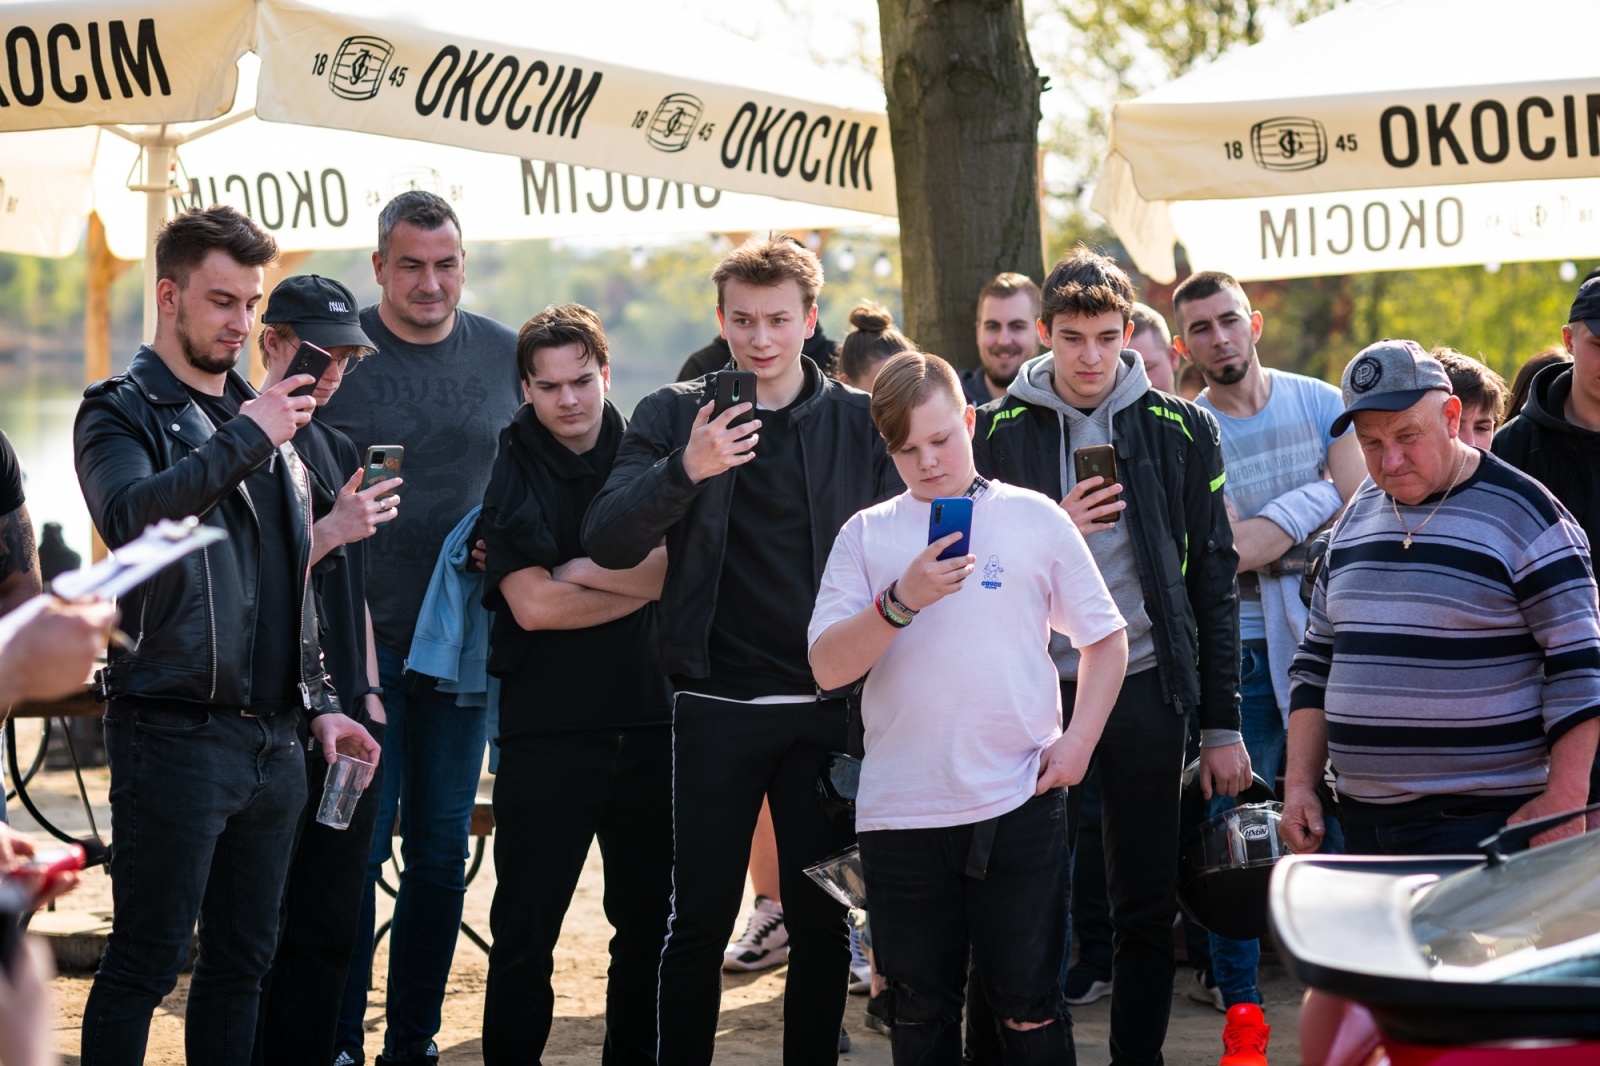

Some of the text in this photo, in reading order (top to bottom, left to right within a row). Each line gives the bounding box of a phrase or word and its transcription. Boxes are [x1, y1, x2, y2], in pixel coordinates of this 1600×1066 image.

[0, 19, 171, 107] OCIM
[312, 53, 328, 76] 18
[388, 65, 408, 88] 45
[416, 45, 602, 138] OKOCIM
[631, 110, 648, 129] 18
[698, 122, 716, 142] 45
[721, 102, 877, 191] OKOCIM
[1225, 141, 1243, 160] 18
[1336, 134, 1358, 152] 45
